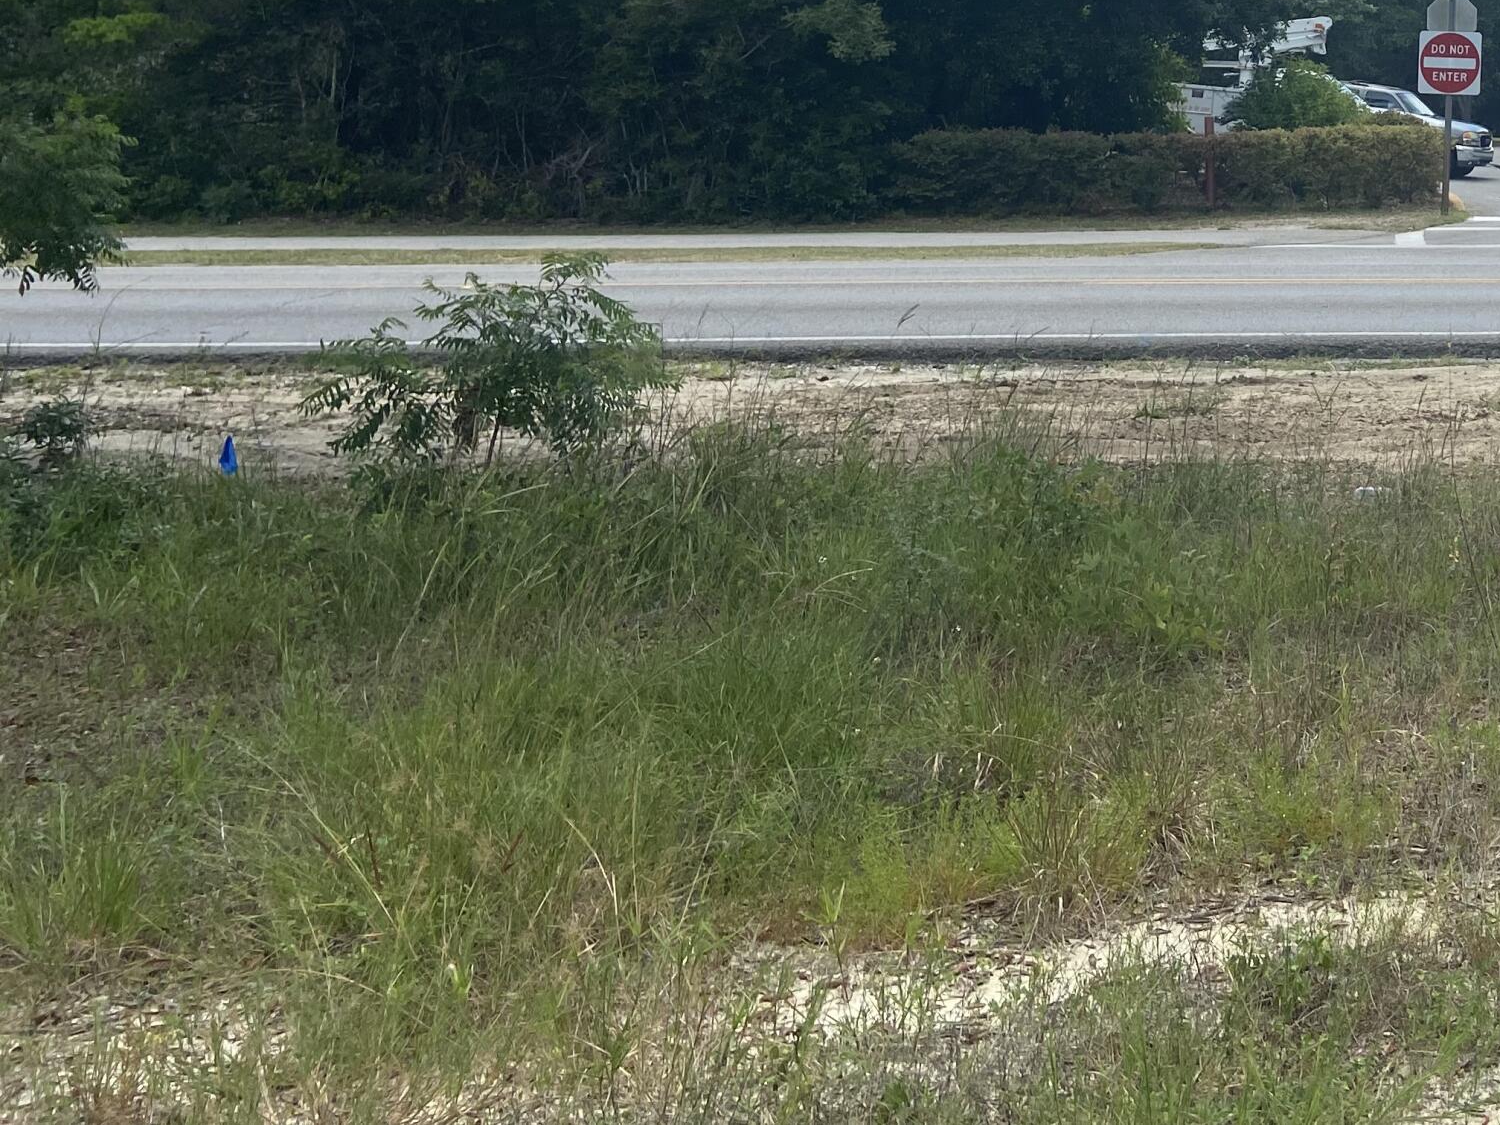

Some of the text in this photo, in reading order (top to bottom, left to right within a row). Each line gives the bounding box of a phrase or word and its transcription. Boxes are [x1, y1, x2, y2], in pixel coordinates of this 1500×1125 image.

[1431, 44, 1470, 55] DO NOT
[1432, 71, 1468, 82] ENTER
